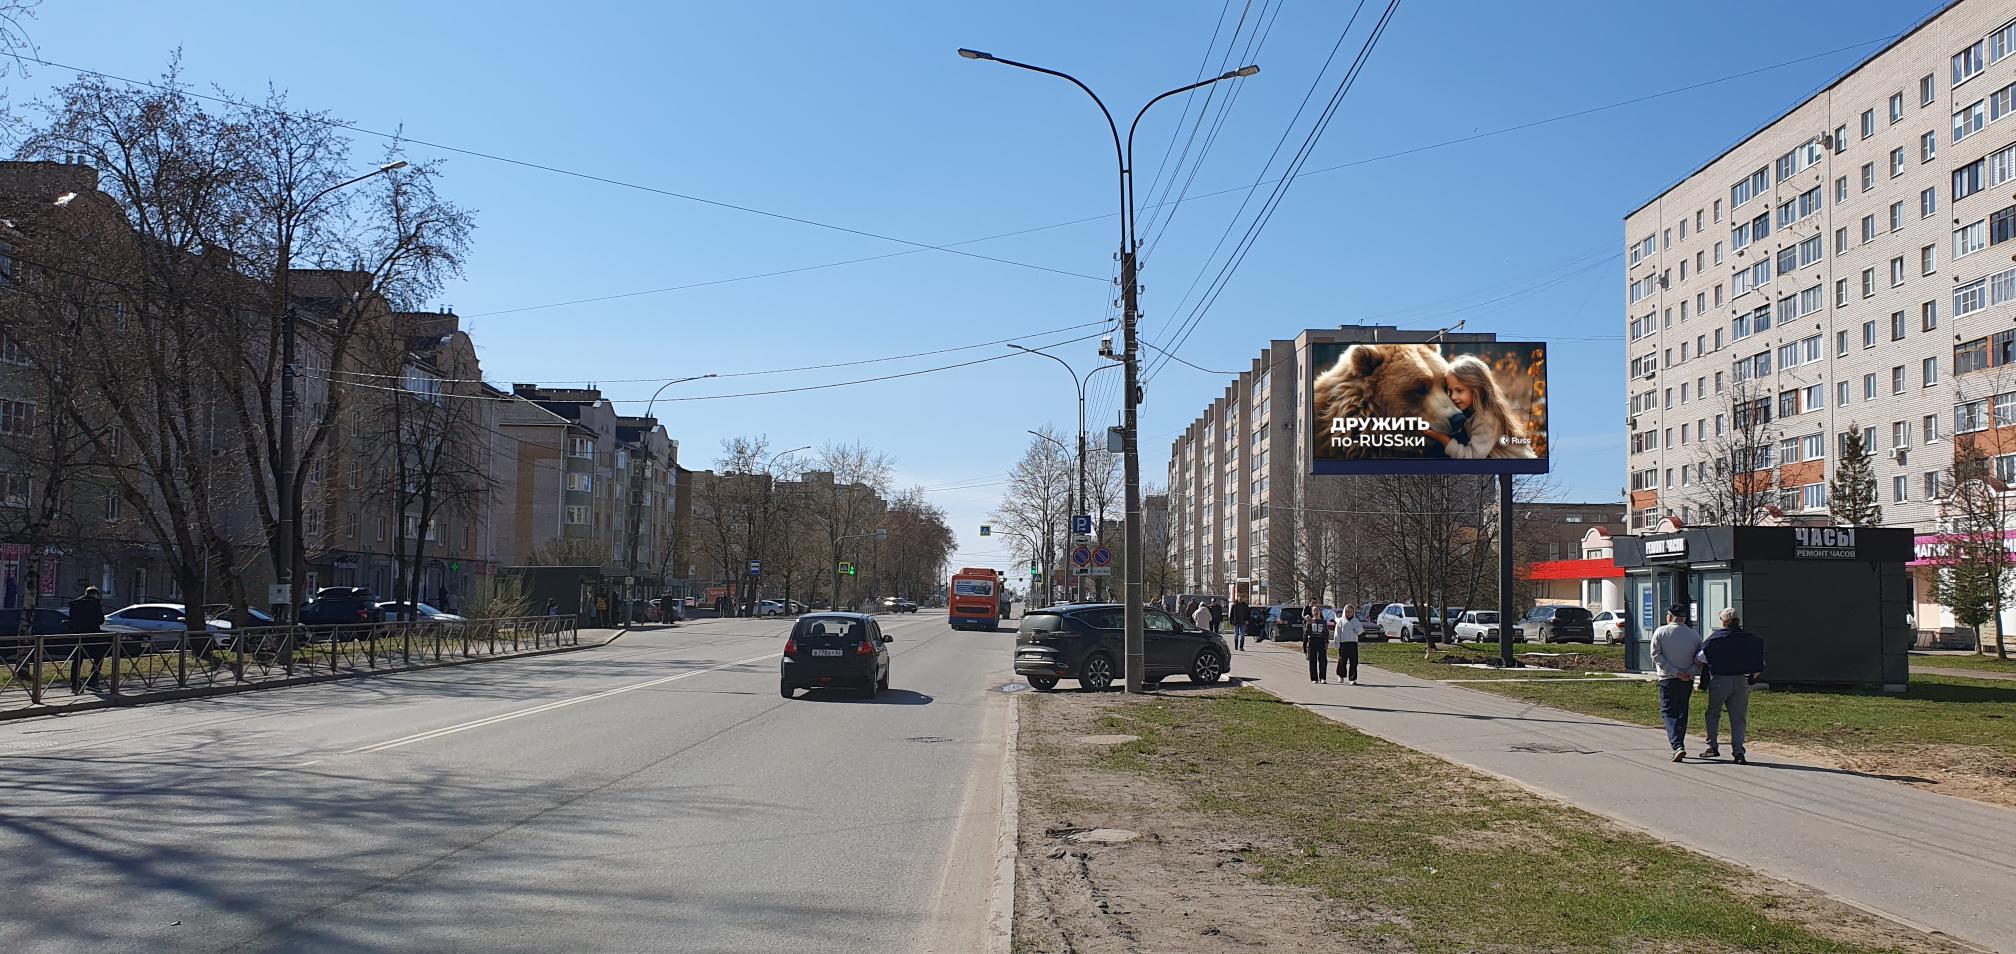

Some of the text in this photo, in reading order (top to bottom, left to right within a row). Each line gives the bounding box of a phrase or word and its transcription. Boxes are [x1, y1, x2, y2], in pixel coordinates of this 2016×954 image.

[1330, 417, 1430, 433] ДРУЖИТЬ
[1331, 434, 1425, 447] по-RUSSки
[1795, 528, 1855, 547] ЧАСЫ
[1829, 550, 1856, 558] ЧАСОВ
